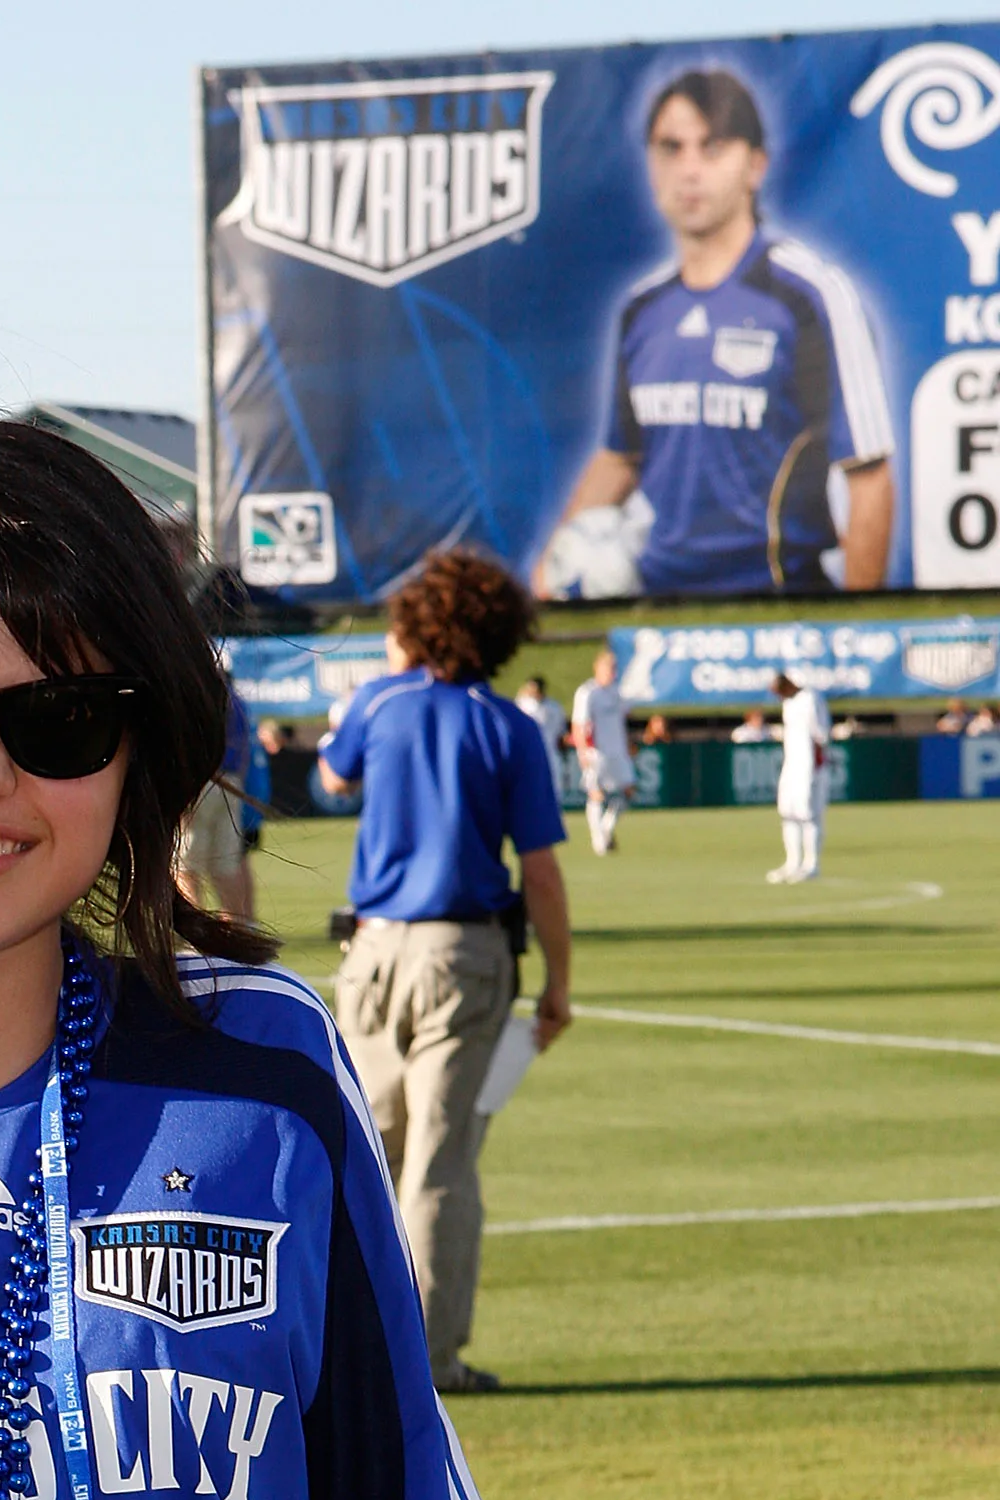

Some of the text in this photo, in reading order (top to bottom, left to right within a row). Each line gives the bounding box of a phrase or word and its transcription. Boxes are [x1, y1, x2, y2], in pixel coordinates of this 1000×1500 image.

[251, 130, 527, 270] WIZARDS
[51, 1111, 61, 1141] BANK
[91, 1223, 264, 1255] KANSAS CITY
[49, 1204, 70, 1341] KANSAS CITY WIZARDS
[91, 1247, 263, 1318] WIZARDS
[67, 1371, 78, 1408] BANK
